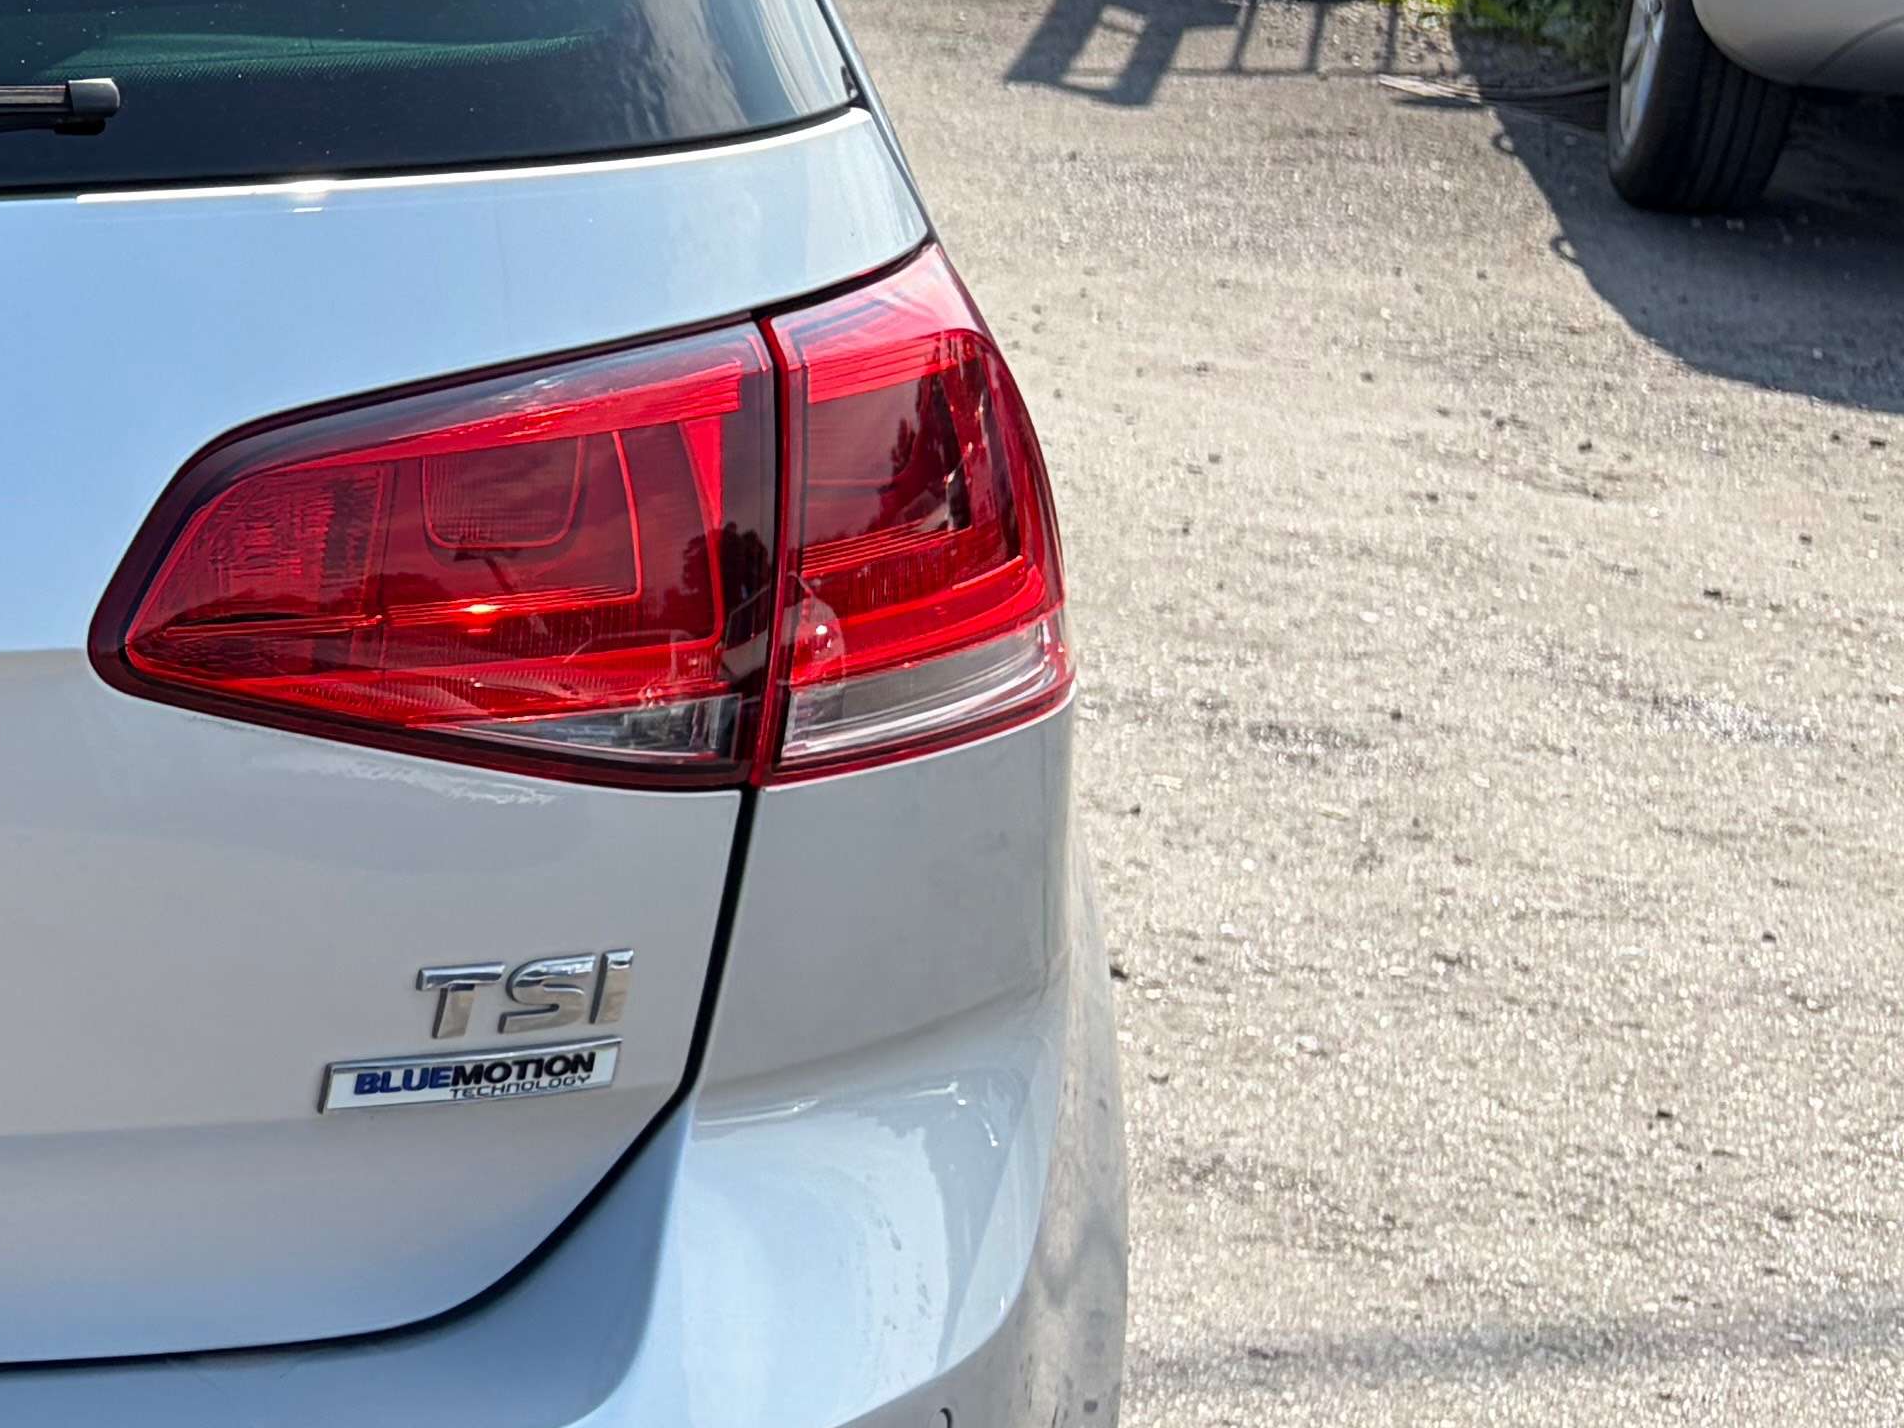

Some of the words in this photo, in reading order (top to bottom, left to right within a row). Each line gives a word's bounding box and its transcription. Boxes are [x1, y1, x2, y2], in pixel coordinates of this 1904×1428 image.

[415, 948, 635, 1040] TSI
[353, 1051, 596, 1095] BLUEMOTION
[449, 1074, 592, 1100] TECHNOLOGY
